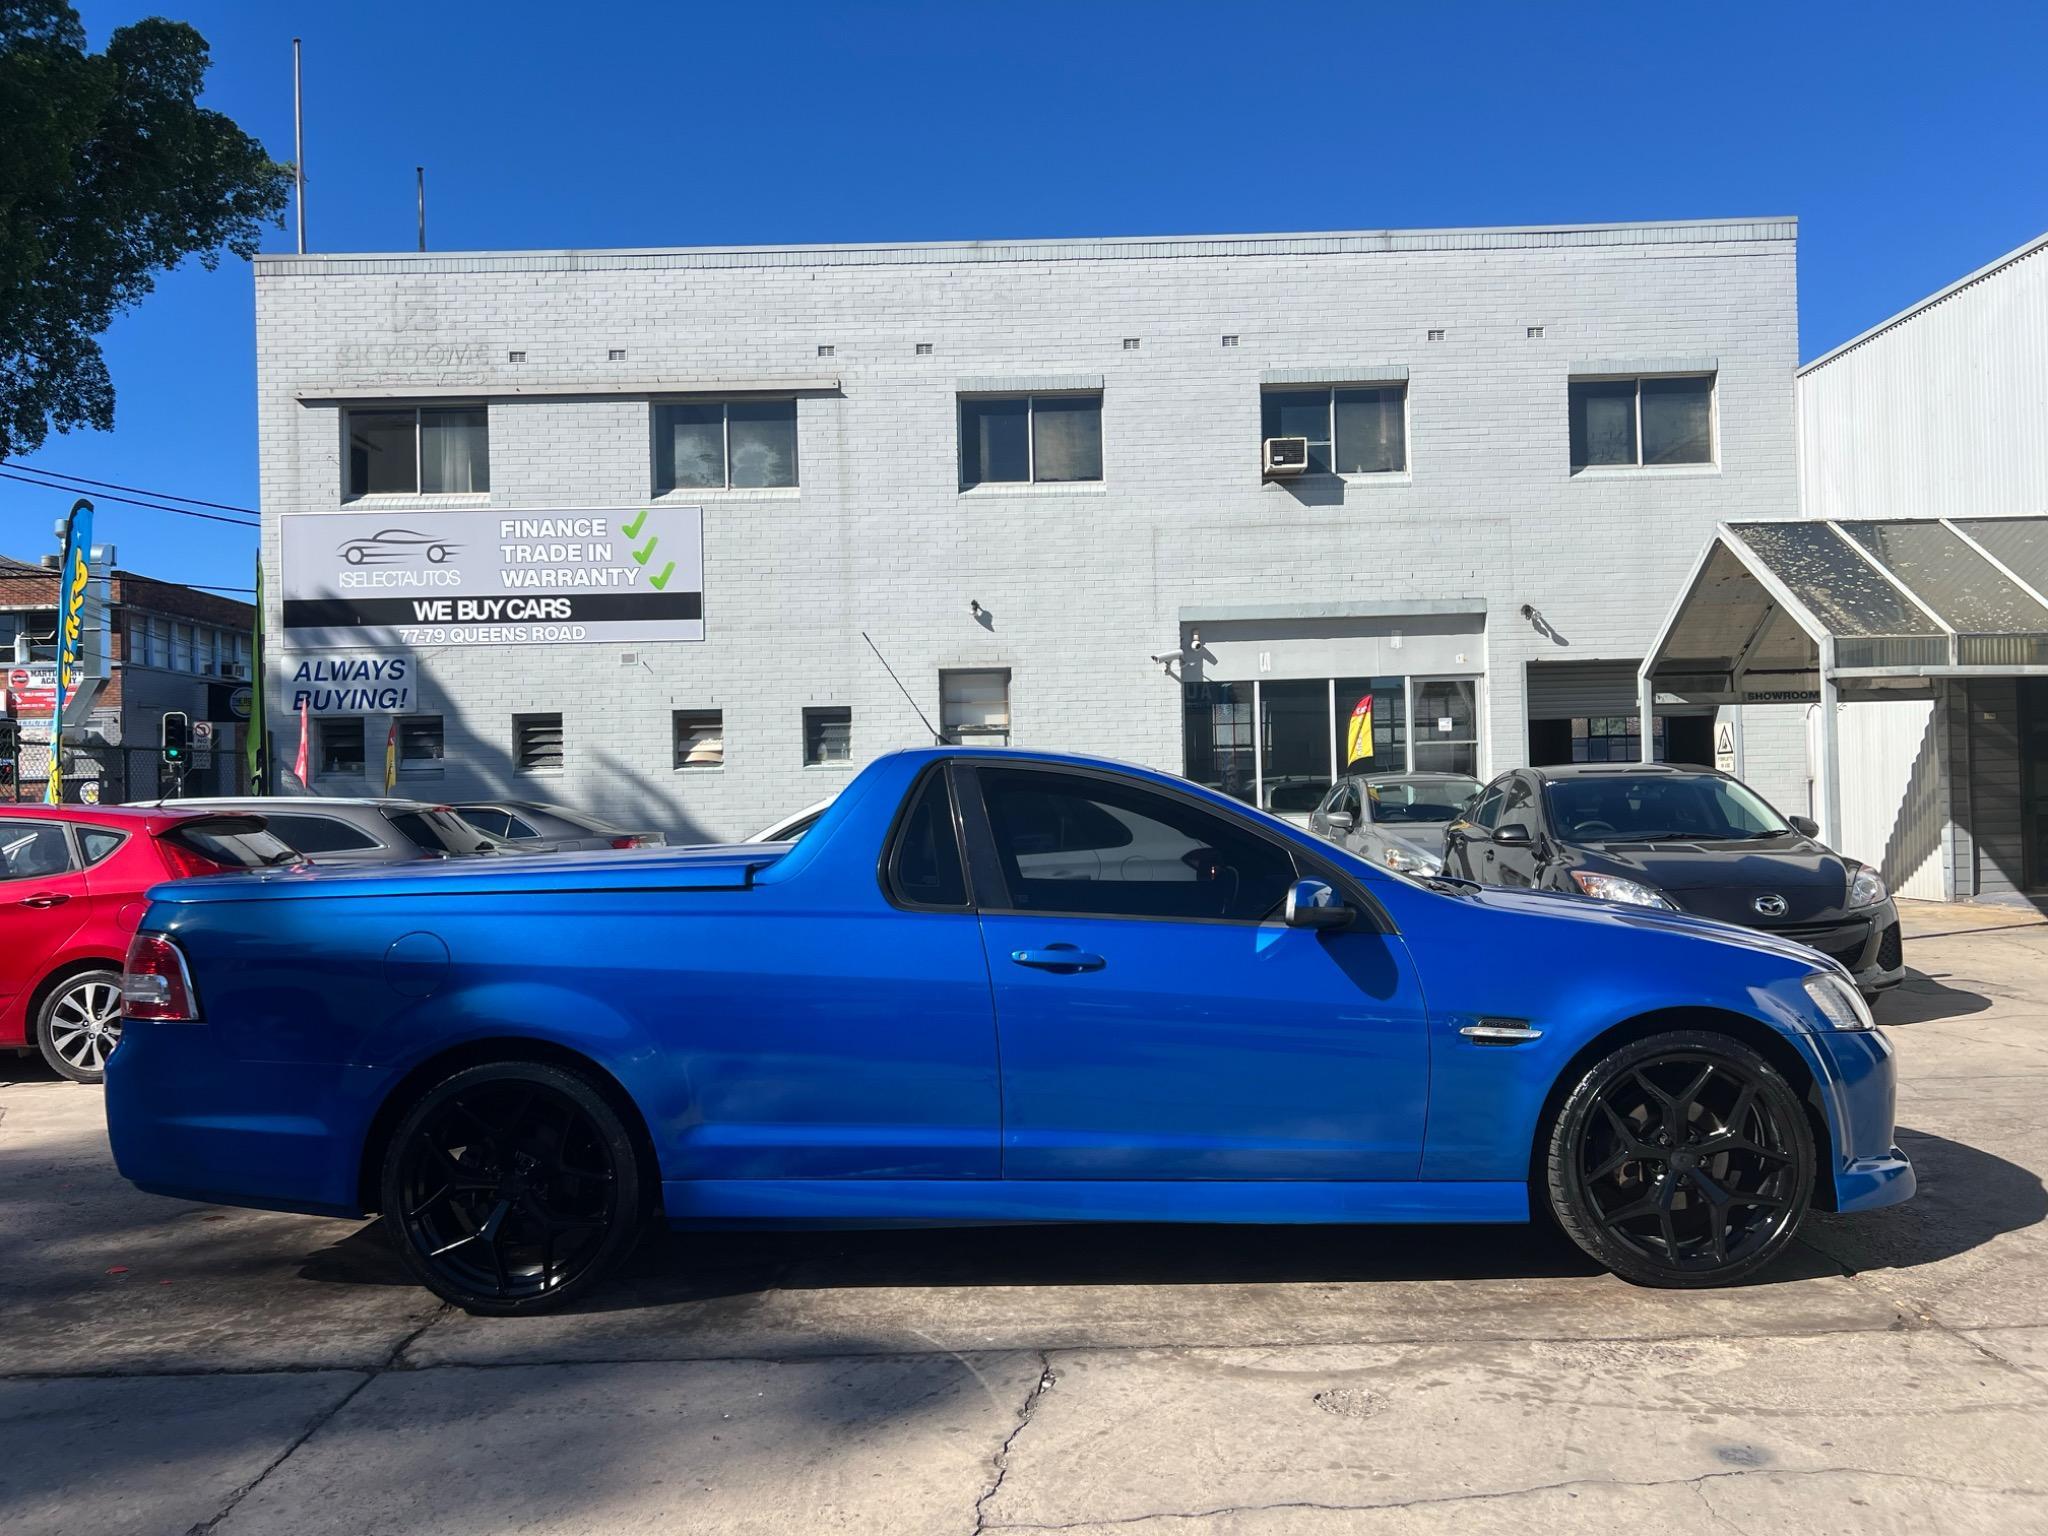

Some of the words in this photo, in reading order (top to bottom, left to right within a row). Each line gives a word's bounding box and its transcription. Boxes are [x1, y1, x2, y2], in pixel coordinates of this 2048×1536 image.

[500, 518, 607, 538] FINANCE
[500, 543, 582, 563] TRADE
[587, 542, 612, 562] IN
[339, 569, 461, 588] ISELECTAUTOS
[500, 567, 640, 588] WARRANTY
[413, 600, 453, 621] WE
[457, 600, 506, 620] BUY
[506, 598, 572, 620] CARS
[399, 628, 446, 643] 77-79
[449, 627, 527, 643] QUEENS
[531, 625, 586, 641] ROAD
[293, 659, 406, 682] ALWAYS
[292, 688, 408, 711] BUYING!
[1747, 691, 1820, 700] SHOWROOM
